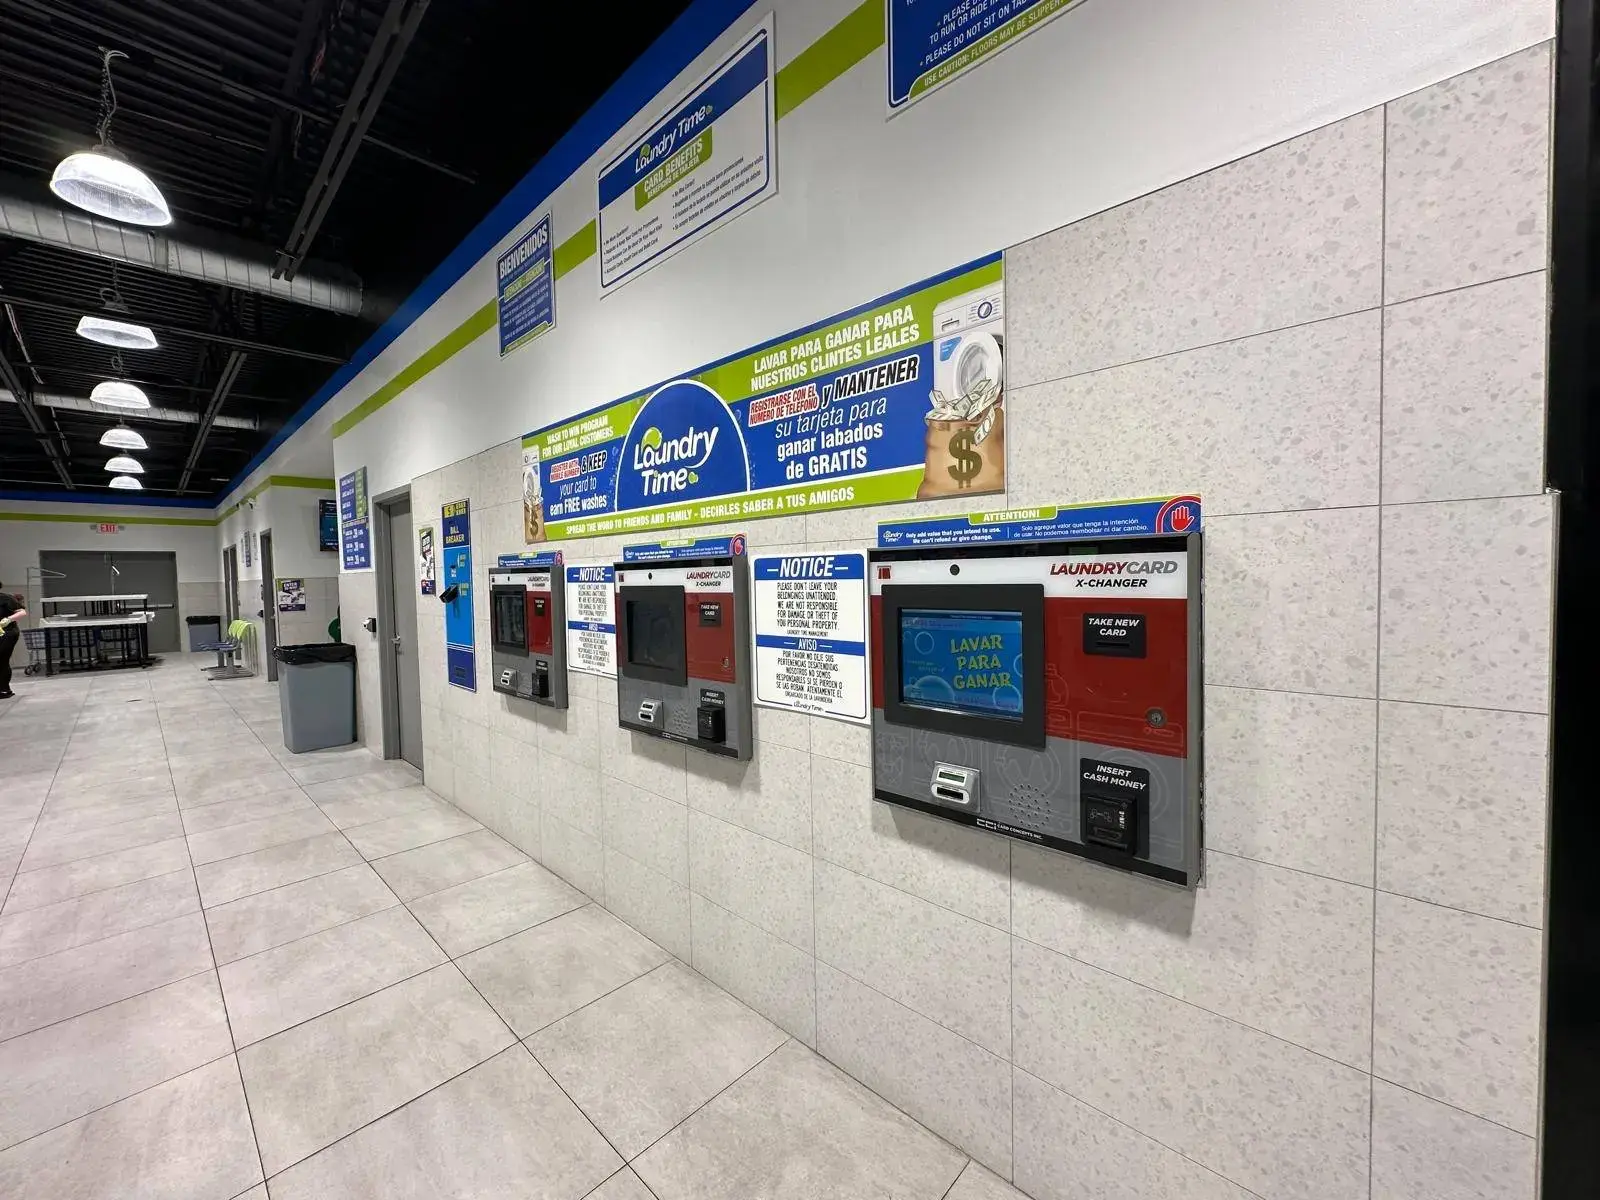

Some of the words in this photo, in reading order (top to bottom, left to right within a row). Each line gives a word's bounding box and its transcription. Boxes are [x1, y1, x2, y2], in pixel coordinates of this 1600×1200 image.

[943, 0, 971, 24] PLEASE
[929, 32, 939, 44] TO
[940, 22, 956, 38] RUN
[957, 13, 968, 27] OR
[970, 1, 988, 18] RIDE
[925, 41, 952, 65] PLEASE
[953, 33, 964, 47] DO
[966, 21, 982, 39] NOT
[983, 12, 996, 28] SIT
[998, 4, 1010, 19] ON
[924, 72, 937, 86] USE
[938, 53, 970, 78] CAUTION:
[971, 35, 998, 58] FLOORS
[1000, 24, 1015, 40] MAY
[1017, 17, 1027, 31] BE
[635, 129, 677, 173] Laundry
[678, 105, 706, 137] Time
[644, 169, 664, 193] CARD
[665, 138, 703, 178] BENEFITS
[500, 223, 548, 280] BIENVENIDOS
[754, 350, 788, 374] LAVAR
[790, 338, 822, 361] PARA
[825, 320, 870, 349] GANAR
[874, 304, 914, 333] PARA
[751, 361, 808, 391] NUESTROS
[810, 342, 862, 373] CLINTES
[866, 323, 919, 356] LEALES
[821, 386, 832, 408] y
[834, 356, 919, 400] MANTENER
[751, 391, 791, 414] REGISTRARSE
[793, 387, 806, 403] CON
[807, 385, 816, 397] EL
[775, 406, 784, 418] DE
[785, 396, 818, 415] TELEFONO
[562, 428, 568, 440] TO
[580, 415, 608, 434] PROGRAM
[775, 421, 792, 439] su
[797, 408, 843, 434] tarjeta
[849, 397, 887, 426] para
[542, 446, 552, 458] FOR
[552, 443, 563, 455] OUR
[580, 426, 613, 446] CUSTOMERS
[634, 426, 719, 471] Laundry
[777, 437, 816, 461] ganar
[821, 422, 883, 449] labados
[588, 452, 607, 471] KEEP
[786, 460, 804, 480] de
[808, 446, 867, 476] GRATIS
[560, 483, 573, 499] your
[574, 476, 588, 493] card
[590, 475, 597, 490] to
[641, 467, 688, 496] Time
[550, 502, 563, 516] earn
[564, 497, 580, 513] FREE
[581, 493, 607, 511] washes
[566, 523, 586, 535] SPREAD
[597, 521, 613, 531] WORD
[615, 519, 622, 529] TO
[623, 515, 649, 527] FRIENDS
[650, 512, 665, 524] AND
[666, 509, 692, 523] FAMILY
[700, 503, 740, 518] DECIRLES
[742, 497, 774, 513] SABER
[776, 496, 784, 509] A
[785, 494, 806, 507] TUS
[809, 486, 855, 505] AMIGOS
[983, 510, 1040, 522] ATTENTION!
[964, 527, 980, 535] intend
[1034, 524, 1056, 533] agregue
[1084, 521, 1101, 529] tenga
[1043, 529, 1069, 537] podemos
[1070, 526, 1102, 534] reembolsar
[1123, 524, 1149, 532] cambio.
[445, 534, 465, 544] BREAKER
[579, 567, 606, 582] NOTICE
[686, 570, 731, 581] LAUNDRYCARD
[780, 556, 835, 578] NOTICE
[1050, 560, 1178, 576] LAUNDRYCARD
[777, 581, 793, 590] PLEASE
[794, 581, 808, 590] DON'T
[808, 581, 822, 591] LEAVE
[824, 581, 838, 591] YOUR
[1075, 578, 1148, 588] X-CHANGER
[777, 591, 804, 600] BELONGINGS
[778, 600, 784, 609] WE
[786, 600, 794, 609] ARE
[796, 601, 805, 610] NOT
[806, 601, 838, 611] RESPONSIBLE
[777, 610, 787, 619] FOR
[787, 610, 805, 619] DAMAGE
[806, 610, 814, 619] OR
[815, 611, 830, 620] THEFT
[831, 611, 838, 621] OF
[777, 618, 787, 627] YOU
[787, 619, 810, 629] PERSONAL
[1088, 617, 1113, 627] TAKE
[1114, 619, 1140, 627] NEW
[1099, 628, 1127, 637] CARD
[798, 638, 817, 651] AVISO
[950, 633, 1004, 656] LAVAR
[778, 657, 807, 668] PERTENENCIAS
[782, 650, 791, 658] POR
[792, 650, 805, 660] FAVOR
[807, 652, 813, 661] NO
[813, 653, 824, 662] DEJE
[825, 654, 834, 663] SUS
[956, 653, 1002, 671] PARA
[776, 673, 806, 684] RESPONSABLES
[806, 677, 812, 685] SI
[812, 678, 818, 687] SE
[819, 679, 838, 689] PIERDEN
[785, 667, 807, 676] NOSOTROS
[808, 669, 815, 678] NO
[953, 672, 1013, 690] GANAR
[776, 681, 782, 689] SE
[782, 682, 790, 690] LAS
[806, 685, 836, 698] ATENTAMENTE
[836, 689, 843, 698] EL
[1096, 764, 1132, 778] INSERT
[1083, 772, 1109, 783] CASH
[1110, 777, 1147, 791] MONEY
